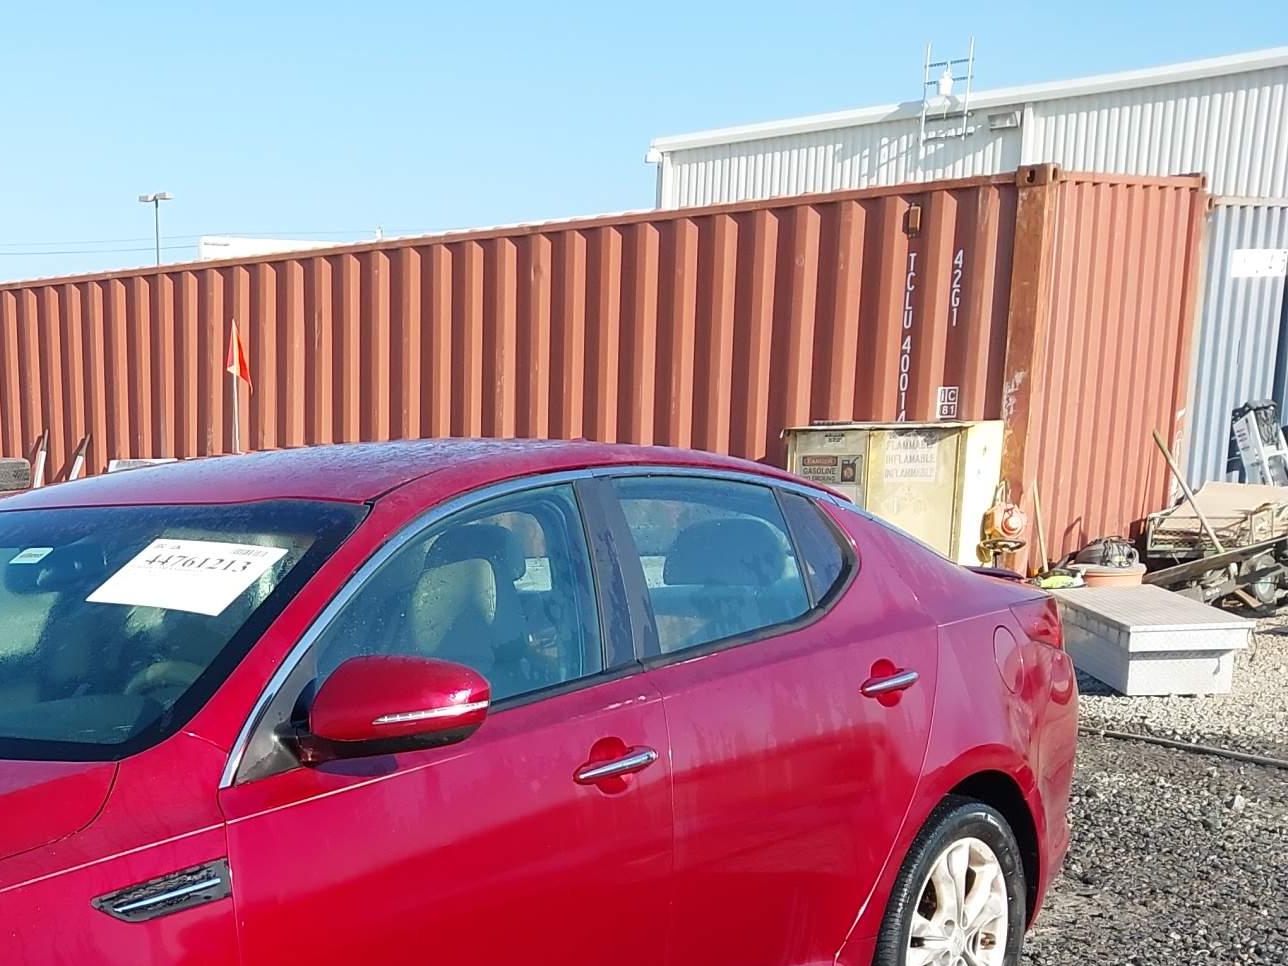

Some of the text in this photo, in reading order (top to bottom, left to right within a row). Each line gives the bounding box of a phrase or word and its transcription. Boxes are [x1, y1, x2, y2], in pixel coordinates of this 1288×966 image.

[904, 252, 917, 329] TCLU
[952, 249, 964, 327] 42G1
[145, 554, 252, 573] 44761213
